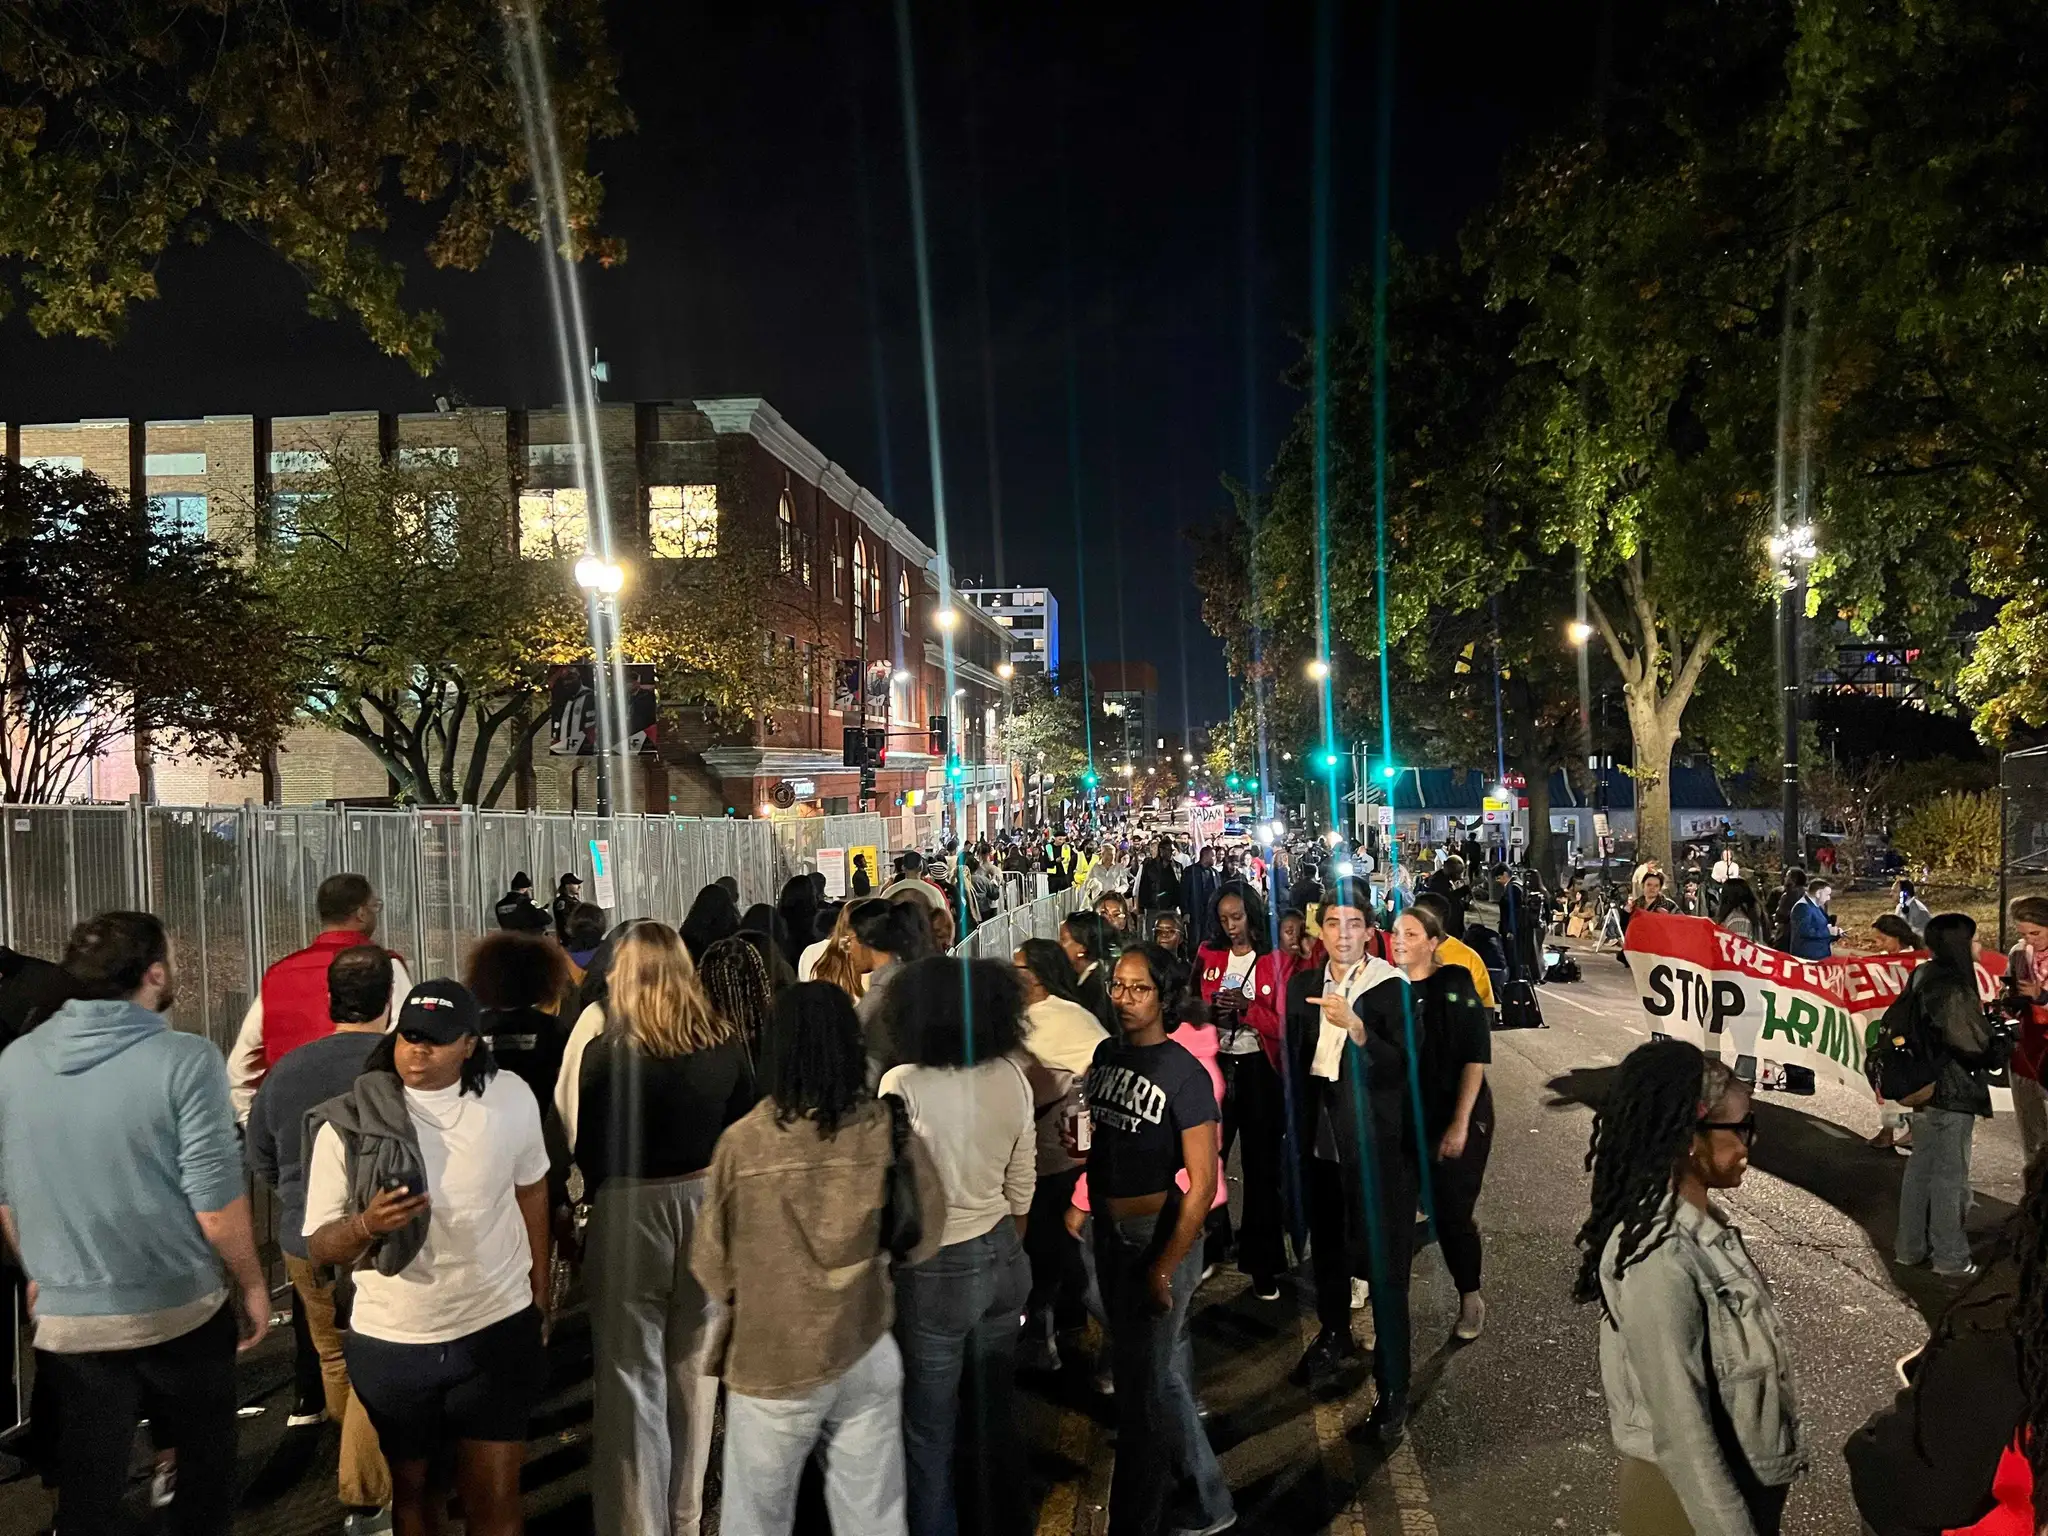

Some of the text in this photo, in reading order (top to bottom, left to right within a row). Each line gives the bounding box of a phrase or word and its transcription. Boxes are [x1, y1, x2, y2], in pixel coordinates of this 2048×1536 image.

[1379, 815, 1392, 823] 25
[1713, 929, 1775, 975] THE
[1642, 963, 1746, 1035] STOP
